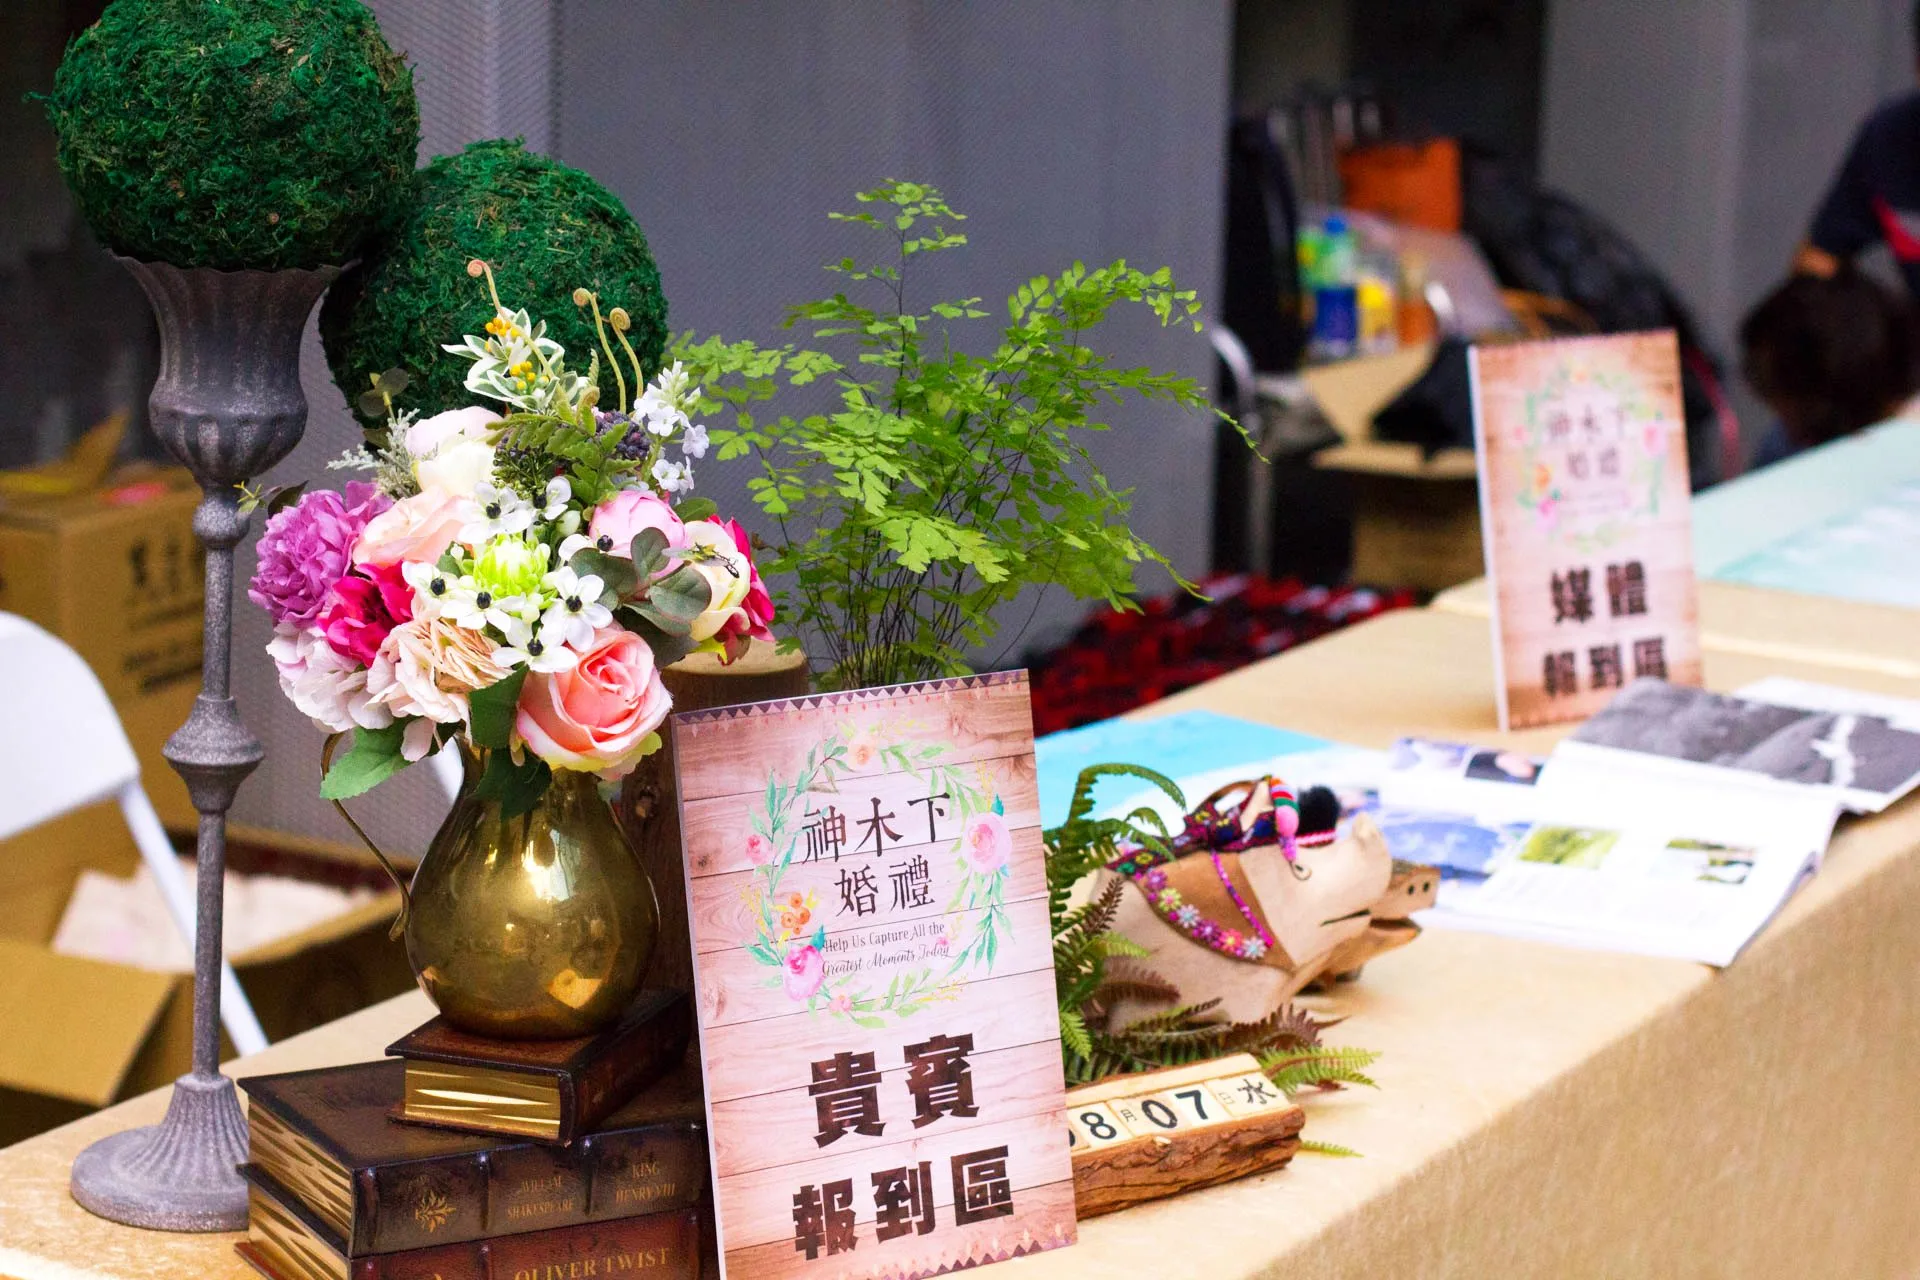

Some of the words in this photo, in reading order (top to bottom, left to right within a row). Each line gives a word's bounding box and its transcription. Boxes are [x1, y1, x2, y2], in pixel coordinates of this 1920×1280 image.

[802, 792, 950, 864] 神木下
[834, 855, 935, 917] 婚禮
[822, 958, 862, 976] Greatest
[867, 949, 915, 970] Moments
[918, 943, 953, 960] Today
[823, 939, 848, 953] Help
[852, 934, 866, 949] Us
[869, 928, 909, 946] Capture
[910, 923, 926, 941] All
[929, 921, 945, 936] the
[808, 1033, 980, 1149] 貴賓
[632, 1161, 659, 1180] KING
[792, 1145, 1014, 1260] 報到區
[514, 1259, 597, 1280] OLIVER
[604, 1247, 669, 1273] TWIST
